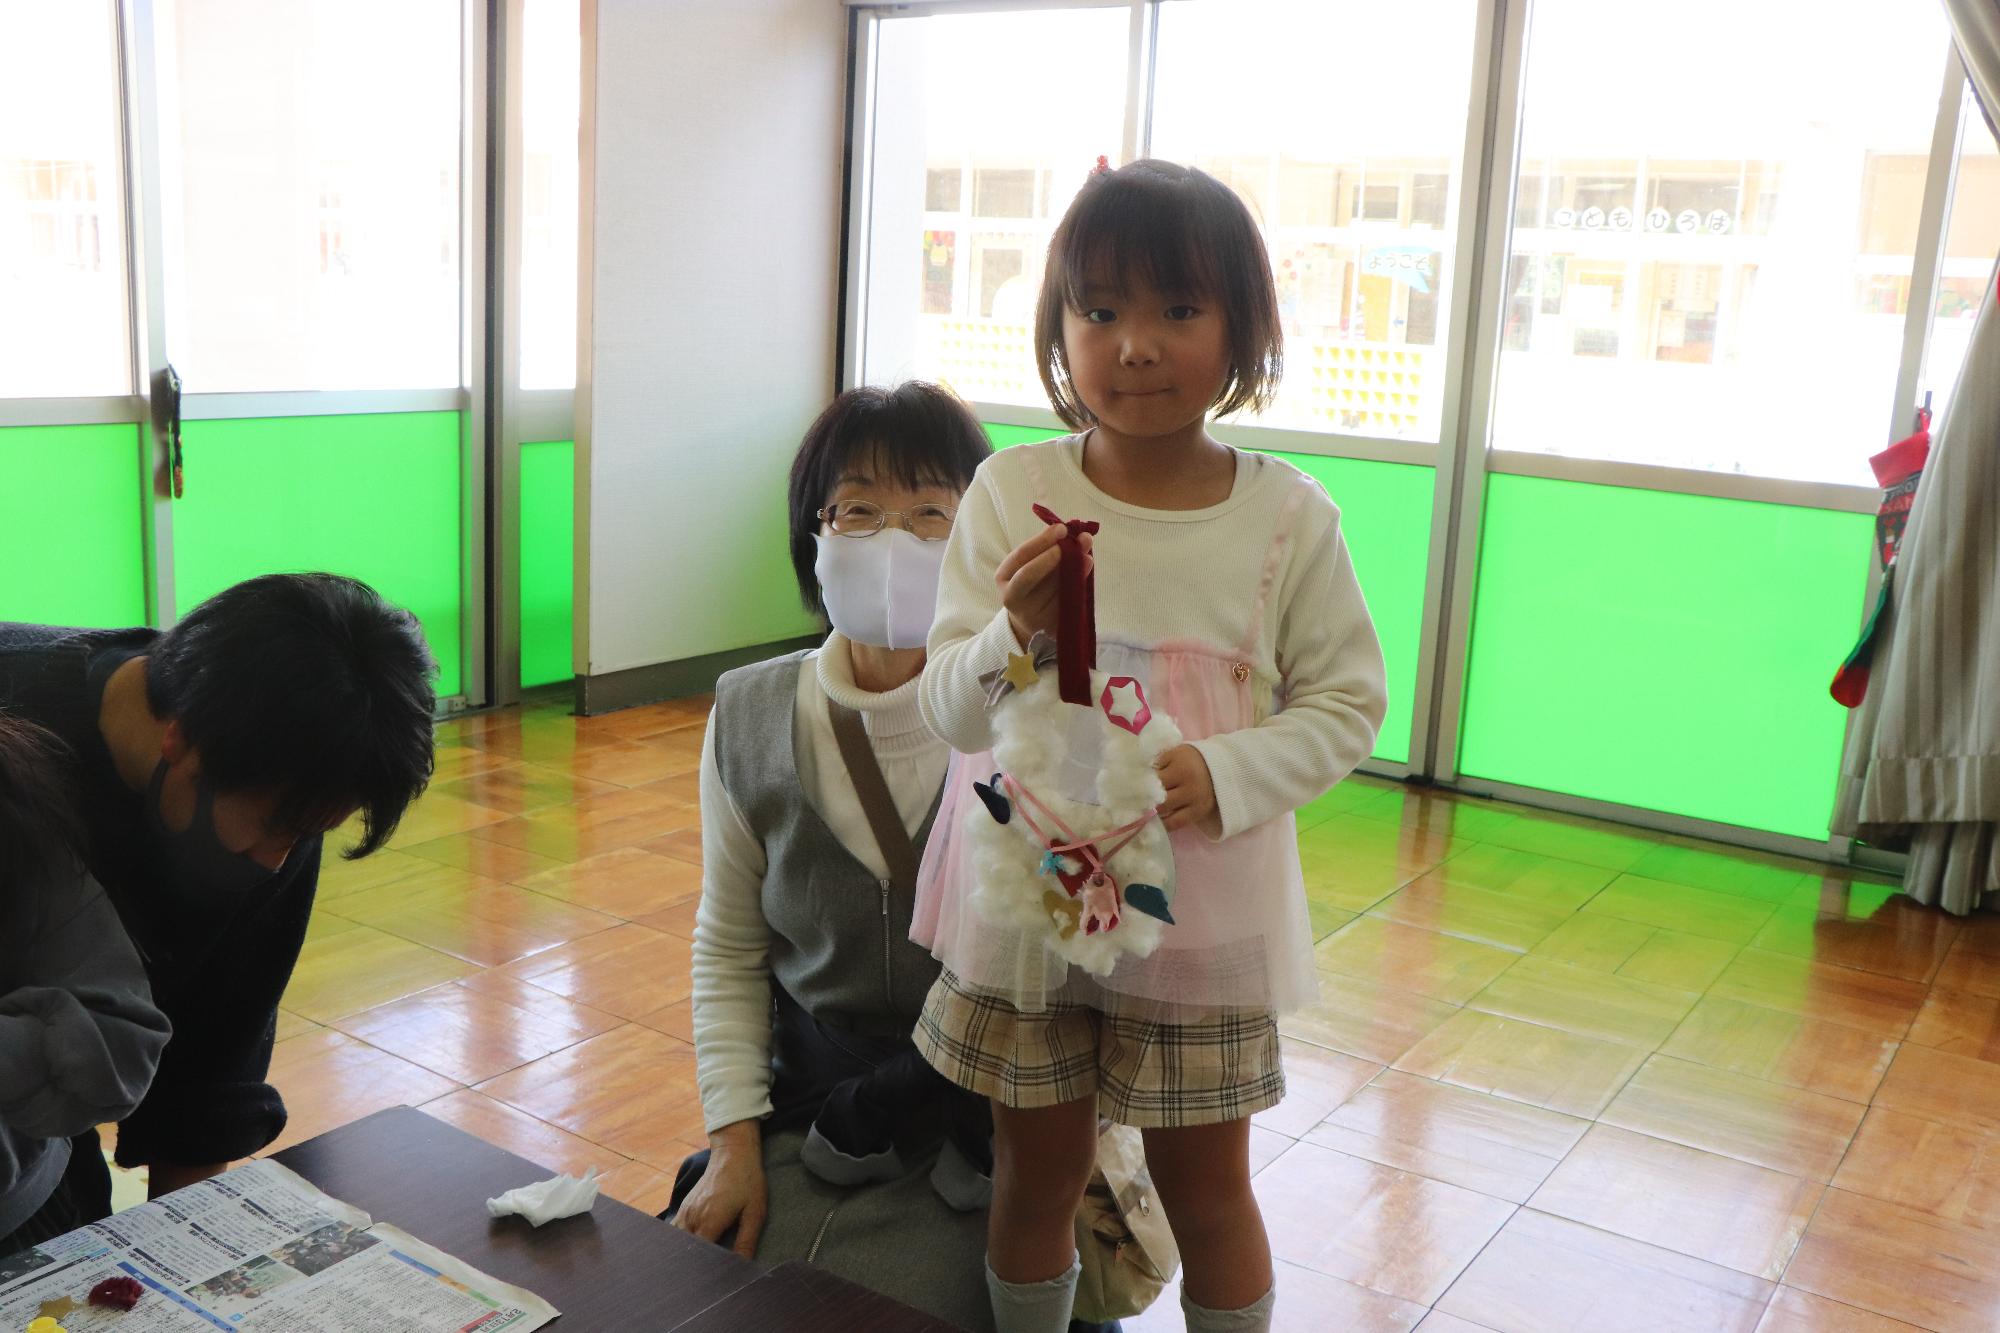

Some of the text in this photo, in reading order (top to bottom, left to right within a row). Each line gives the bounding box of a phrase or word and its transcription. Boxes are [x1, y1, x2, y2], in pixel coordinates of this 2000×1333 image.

[1557, 209, 1729, 231] こどもひろば
[1368, 253, 1427, 271] ようこそ
